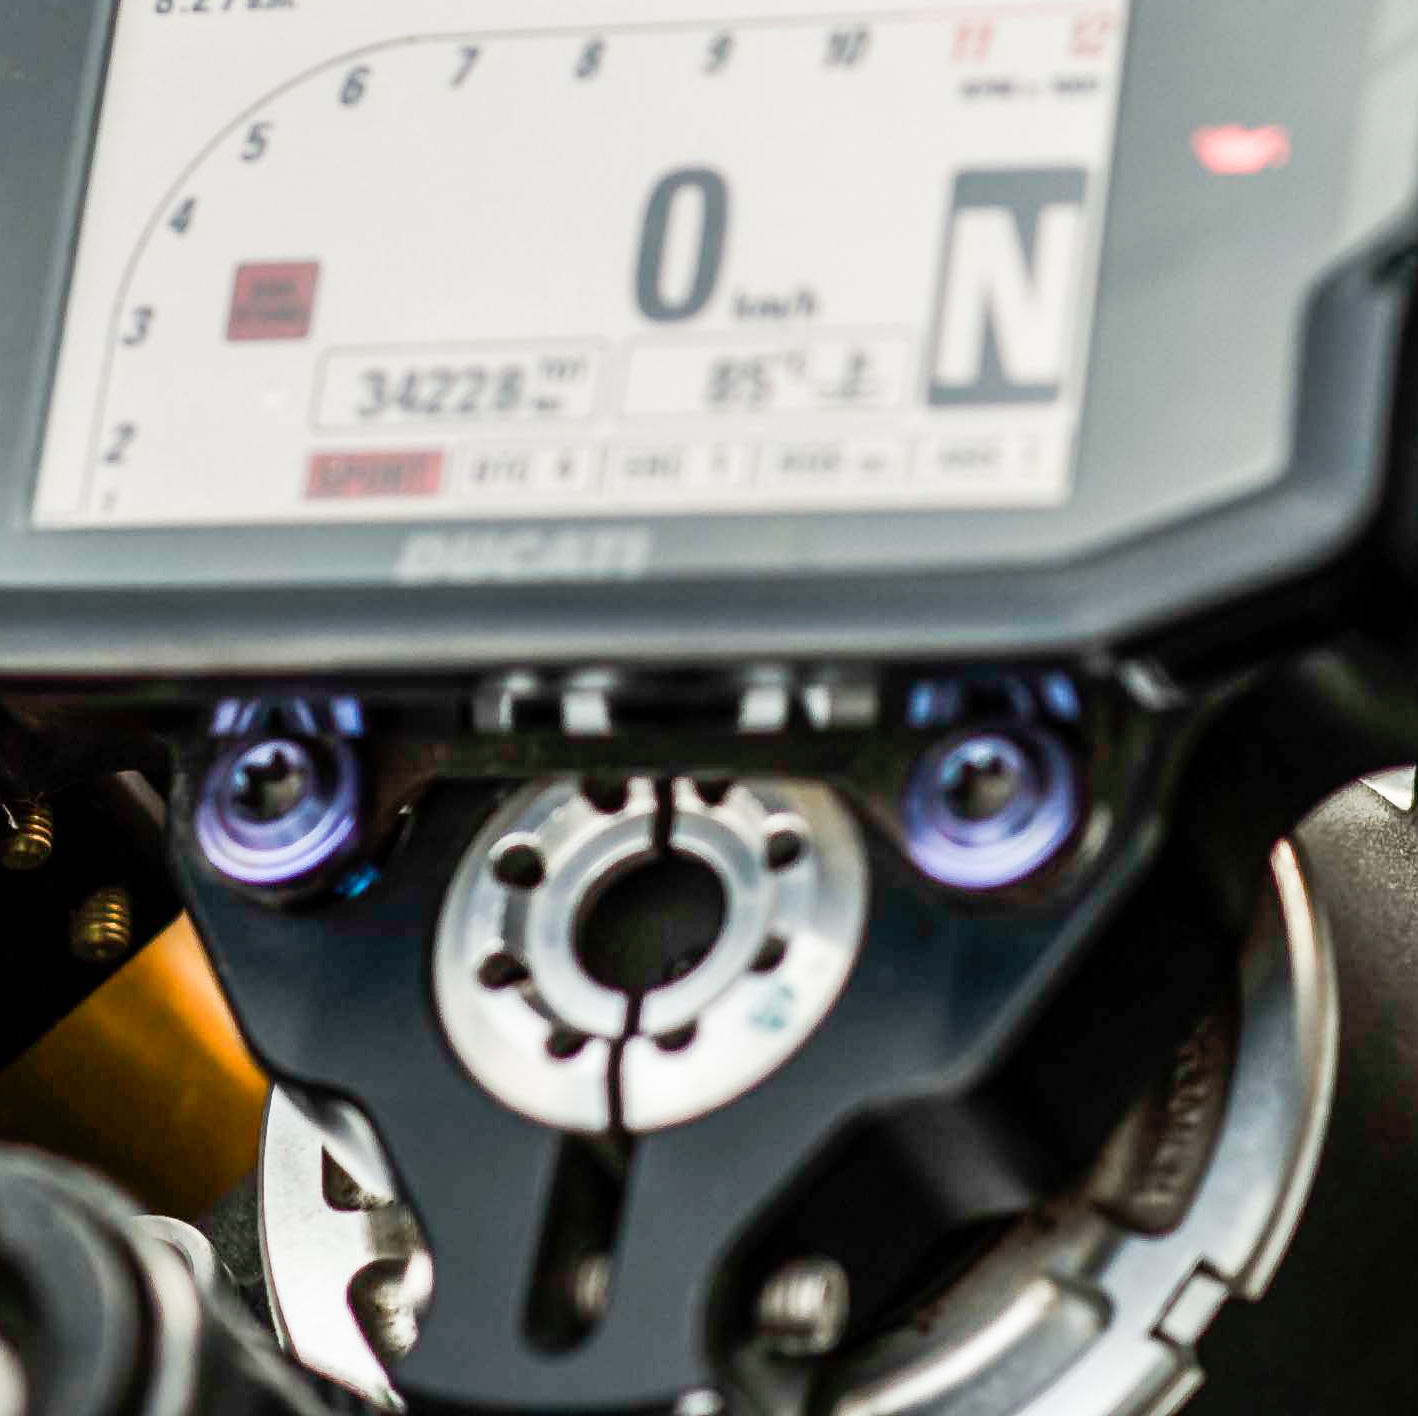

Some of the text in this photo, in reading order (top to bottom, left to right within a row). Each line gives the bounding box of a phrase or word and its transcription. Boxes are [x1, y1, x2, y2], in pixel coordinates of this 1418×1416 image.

[450, 44, 482, 87] 7
[574, 37, 606, 81] 8
[705, 30, 735, 74] 9
[824, 23, 871, 68] 10
[338, 65, 371, 108] 6
[241, 121, 271, 163] 5
[168, 197, 197, 235] 4
[633, 164, 731, 324] 0
[934, 200, 1081, 388] N
[121, 305, 156, 348] 3
[357, 365, 525, 420] 34228
[103, 422, 137, 466] 2
